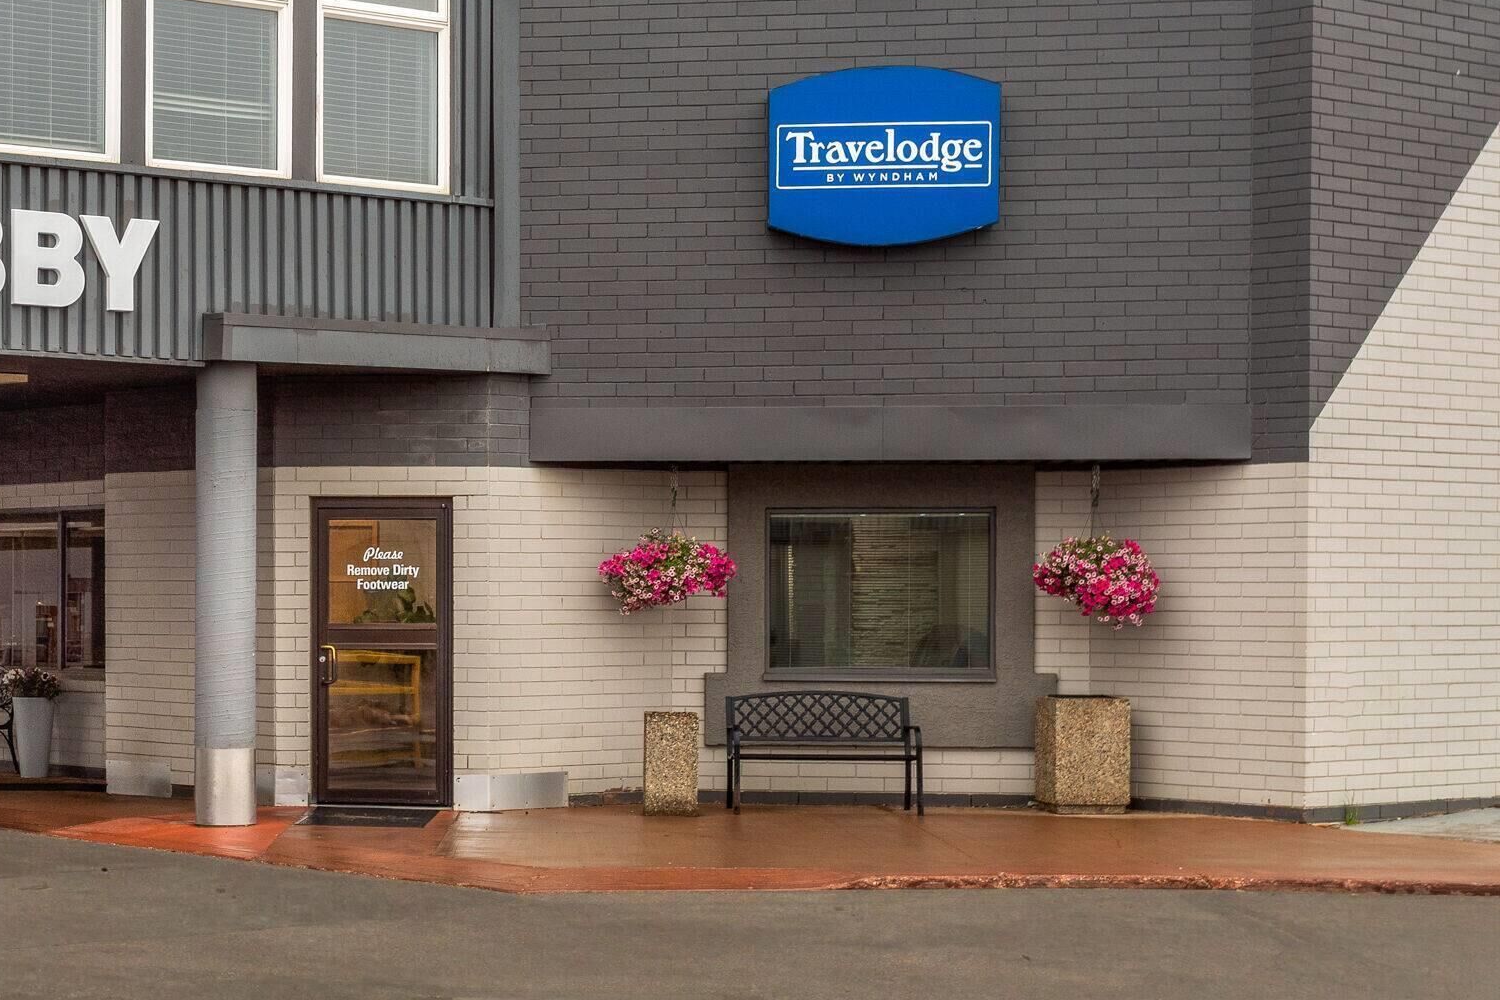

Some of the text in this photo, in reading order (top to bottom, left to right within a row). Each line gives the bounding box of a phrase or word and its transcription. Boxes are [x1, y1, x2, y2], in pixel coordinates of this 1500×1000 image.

[785, 128, 983, 172] Travelodge
[826, 172, 938, 183] BY WYNDHAM
[363, 547, 403, 561] Please
[347, 564, 420, 577] Remove Dirty
[357, 579, 409, 590] Footwear
